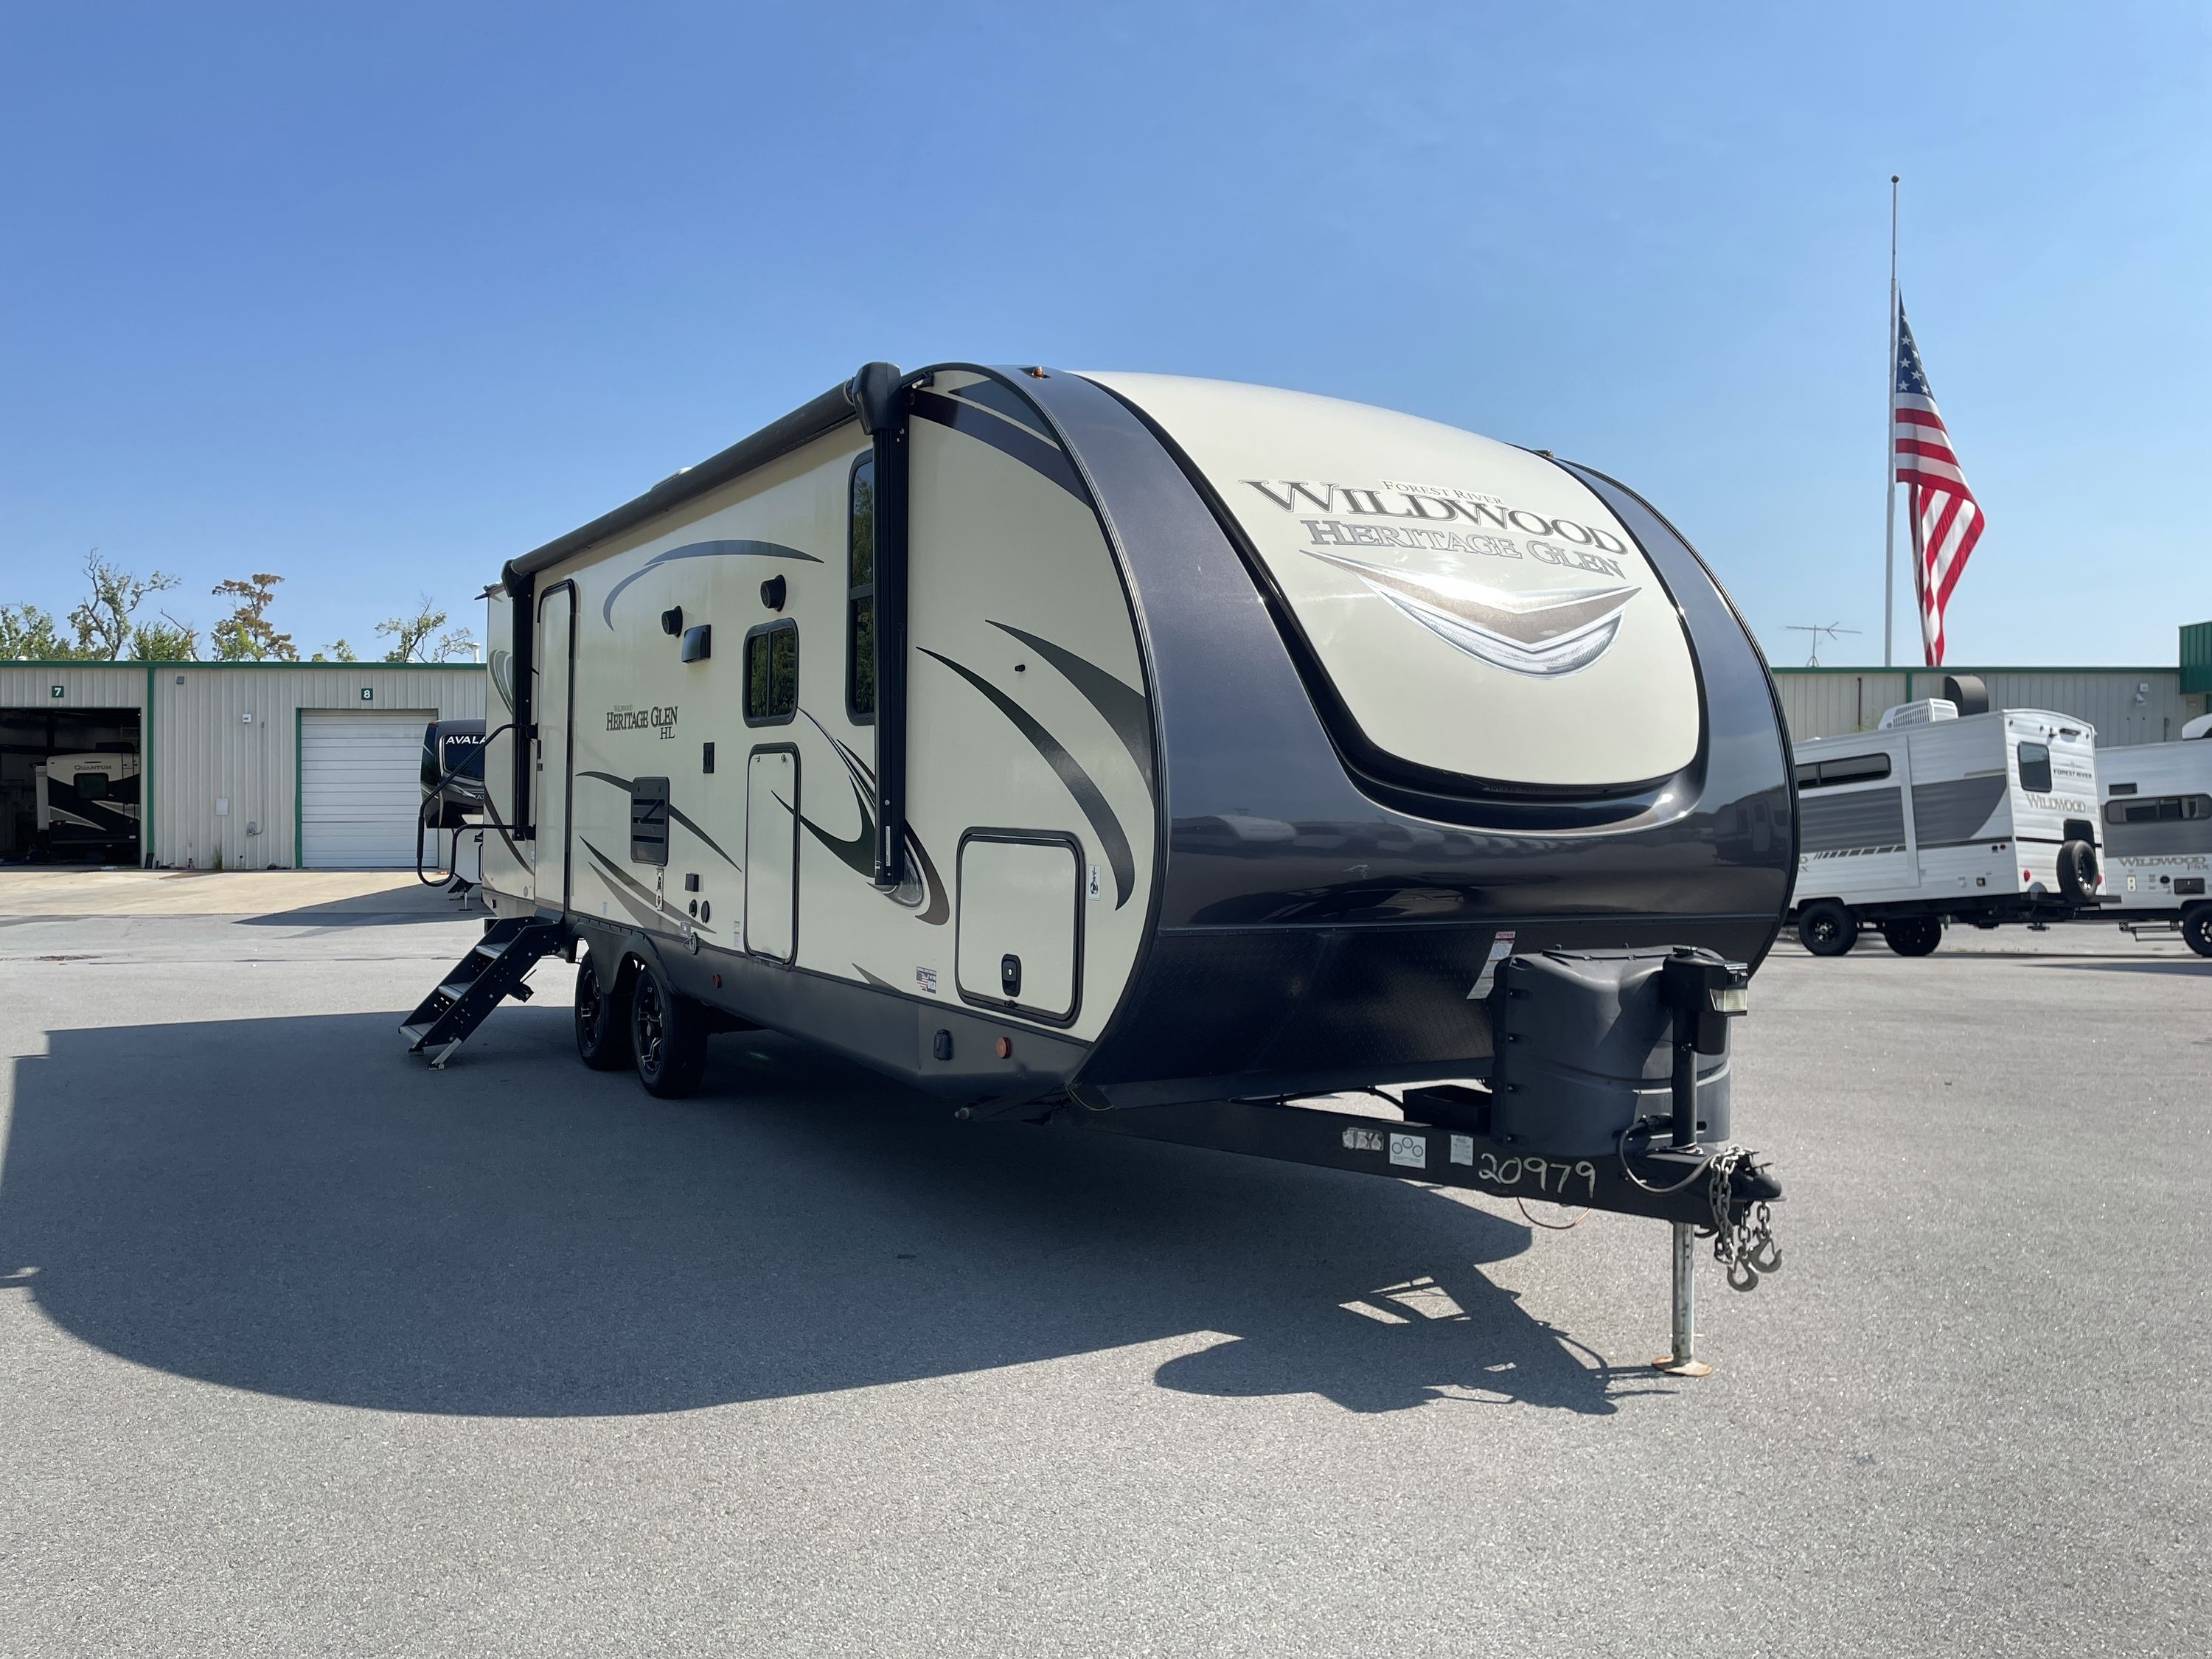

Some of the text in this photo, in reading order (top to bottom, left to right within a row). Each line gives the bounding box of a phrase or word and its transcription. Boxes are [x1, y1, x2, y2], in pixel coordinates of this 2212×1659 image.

[1381, 480, 1504, 506] FOREST RIVER
[1238, 479, 1628, 555] WILDWOOD
[1300, 519, 1627, 580] HERITAGE GLEN
[55, 687, 62, 696] 7
[364, 689, 371, 699] 8
[606, 706, 678, 731] HERITAGE GLEN
[660, 726, 675, 740] HL
[2053, 768, 2075, 776] FOREST
[2025, 793, 2086, 813] WILDWOOD
[2118, 855, 2207, 867] WILDWOOD
[1478, 1152, 1596, 1199] 20979
